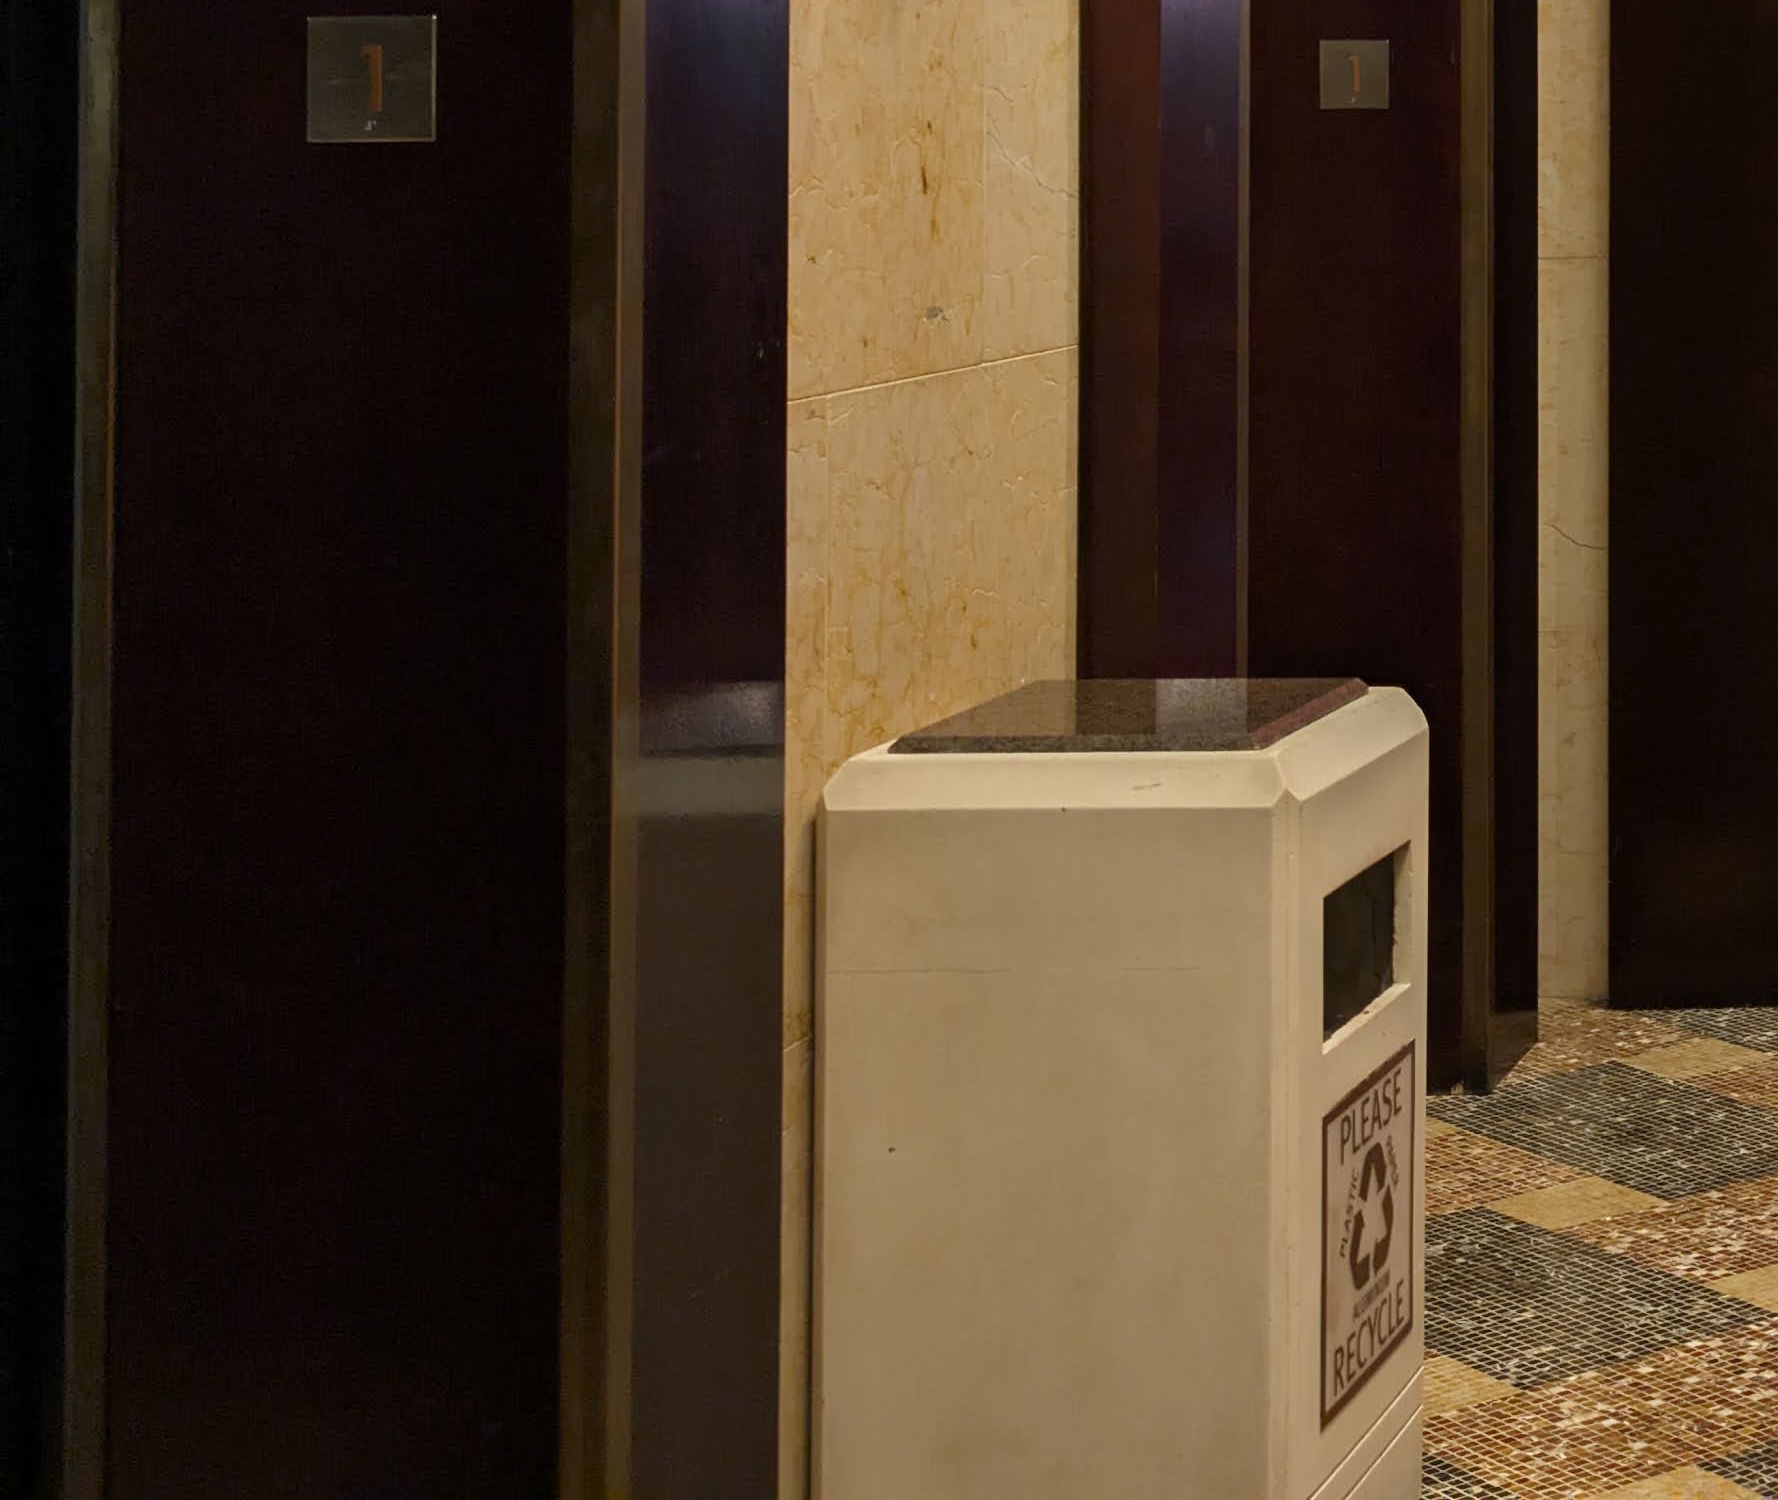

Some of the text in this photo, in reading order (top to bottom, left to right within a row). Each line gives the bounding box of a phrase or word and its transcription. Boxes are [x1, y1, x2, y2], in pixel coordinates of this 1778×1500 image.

[360, 45, 383, 113] 1
[1344, 53, 1361, 94] 1
[1340, 1067, 1402, 1166] PLEASE
[1333, 1279, 1404, 1396] RECYCLE
